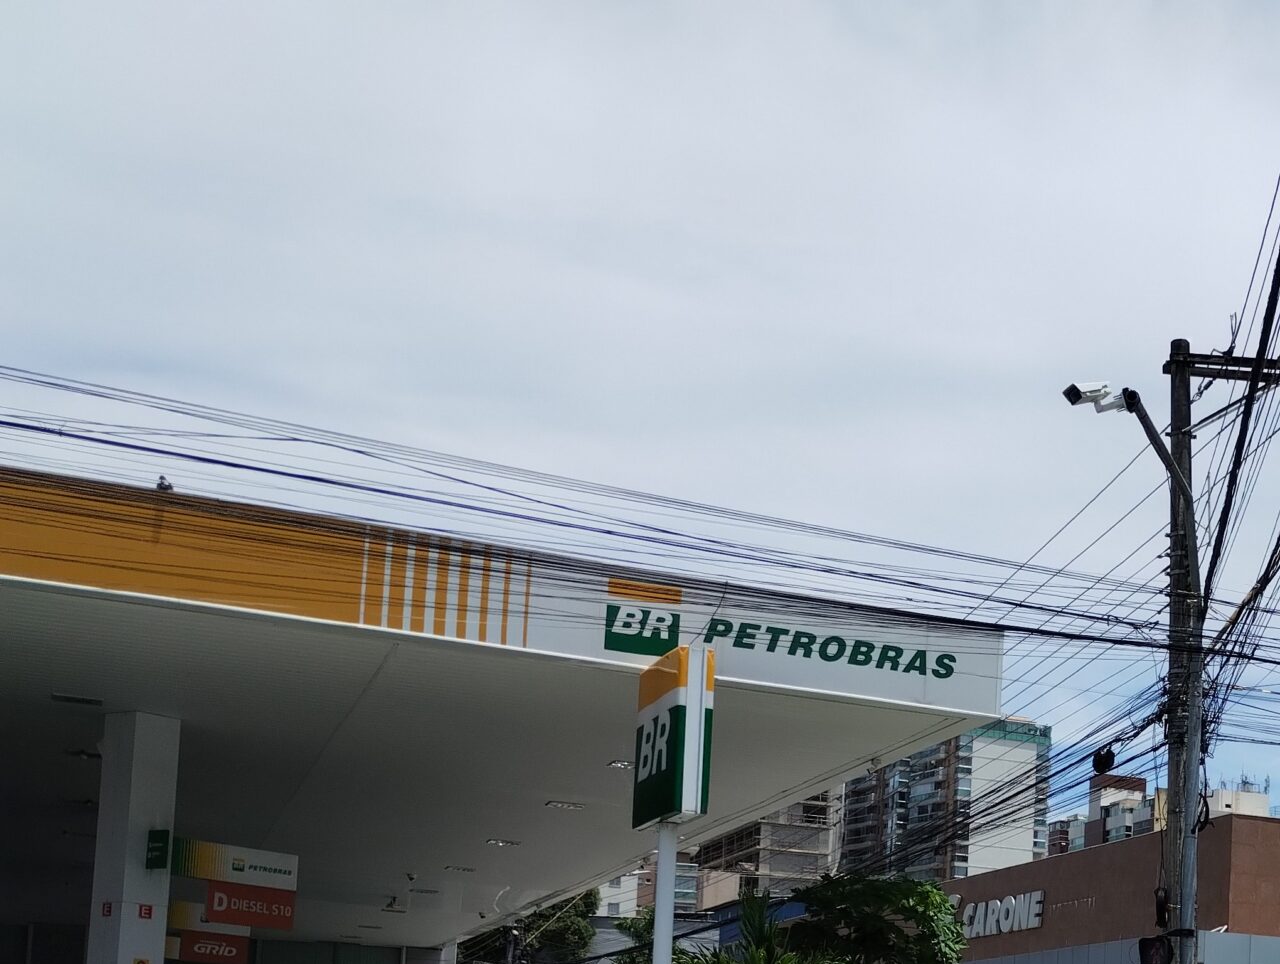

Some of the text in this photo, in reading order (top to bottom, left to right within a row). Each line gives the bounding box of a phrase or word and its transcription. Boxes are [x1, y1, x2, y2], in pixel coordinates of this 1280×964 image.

[611, 606, 957, 680] BR PETROBRAS
[638, 708, 672, 784] BR
[248, 864, 292, 876] PETROBRAS
[141, 906, 150, 917] E
[213, 892, 292, 917] D DIESEL S10
[962, 890, 1046, 939] CARONE
